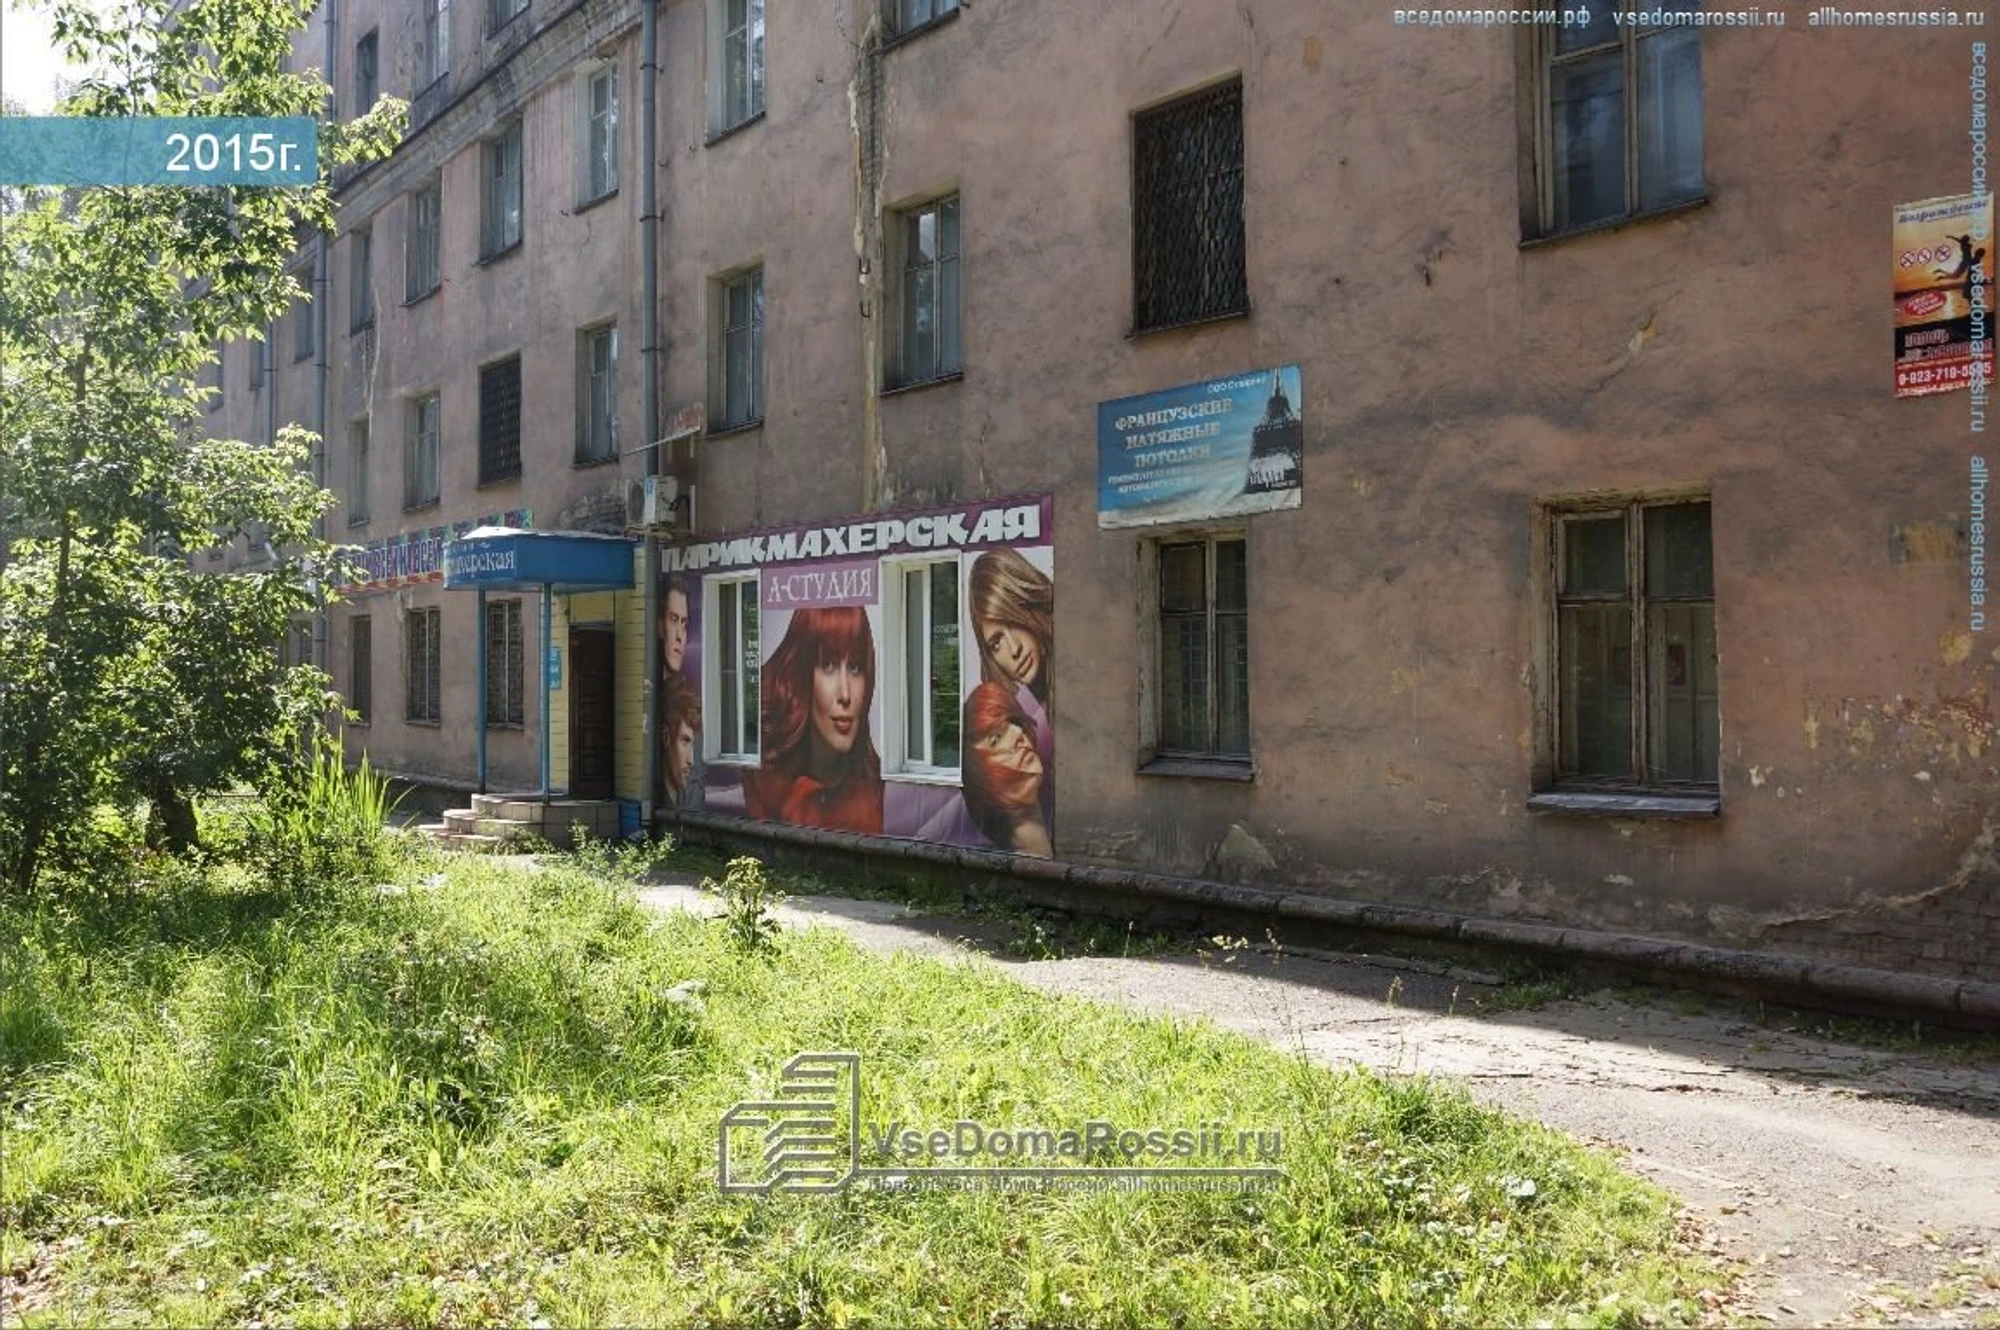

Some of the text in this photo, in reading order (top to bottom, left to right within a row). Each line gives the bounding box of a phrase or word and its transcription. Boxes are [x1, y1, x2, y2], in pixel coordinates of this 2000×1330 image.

[1115, 398, 1233, 431] ФРАНЦУЗСКИЕ
[1125, 421, 1221, 450] НАТЯЖНЫЕ
[661, 504, 1041, 574] ПАРИКМАХЕРСКАЯ
[767, 567, 874, 604] А-СТУДИЯ
